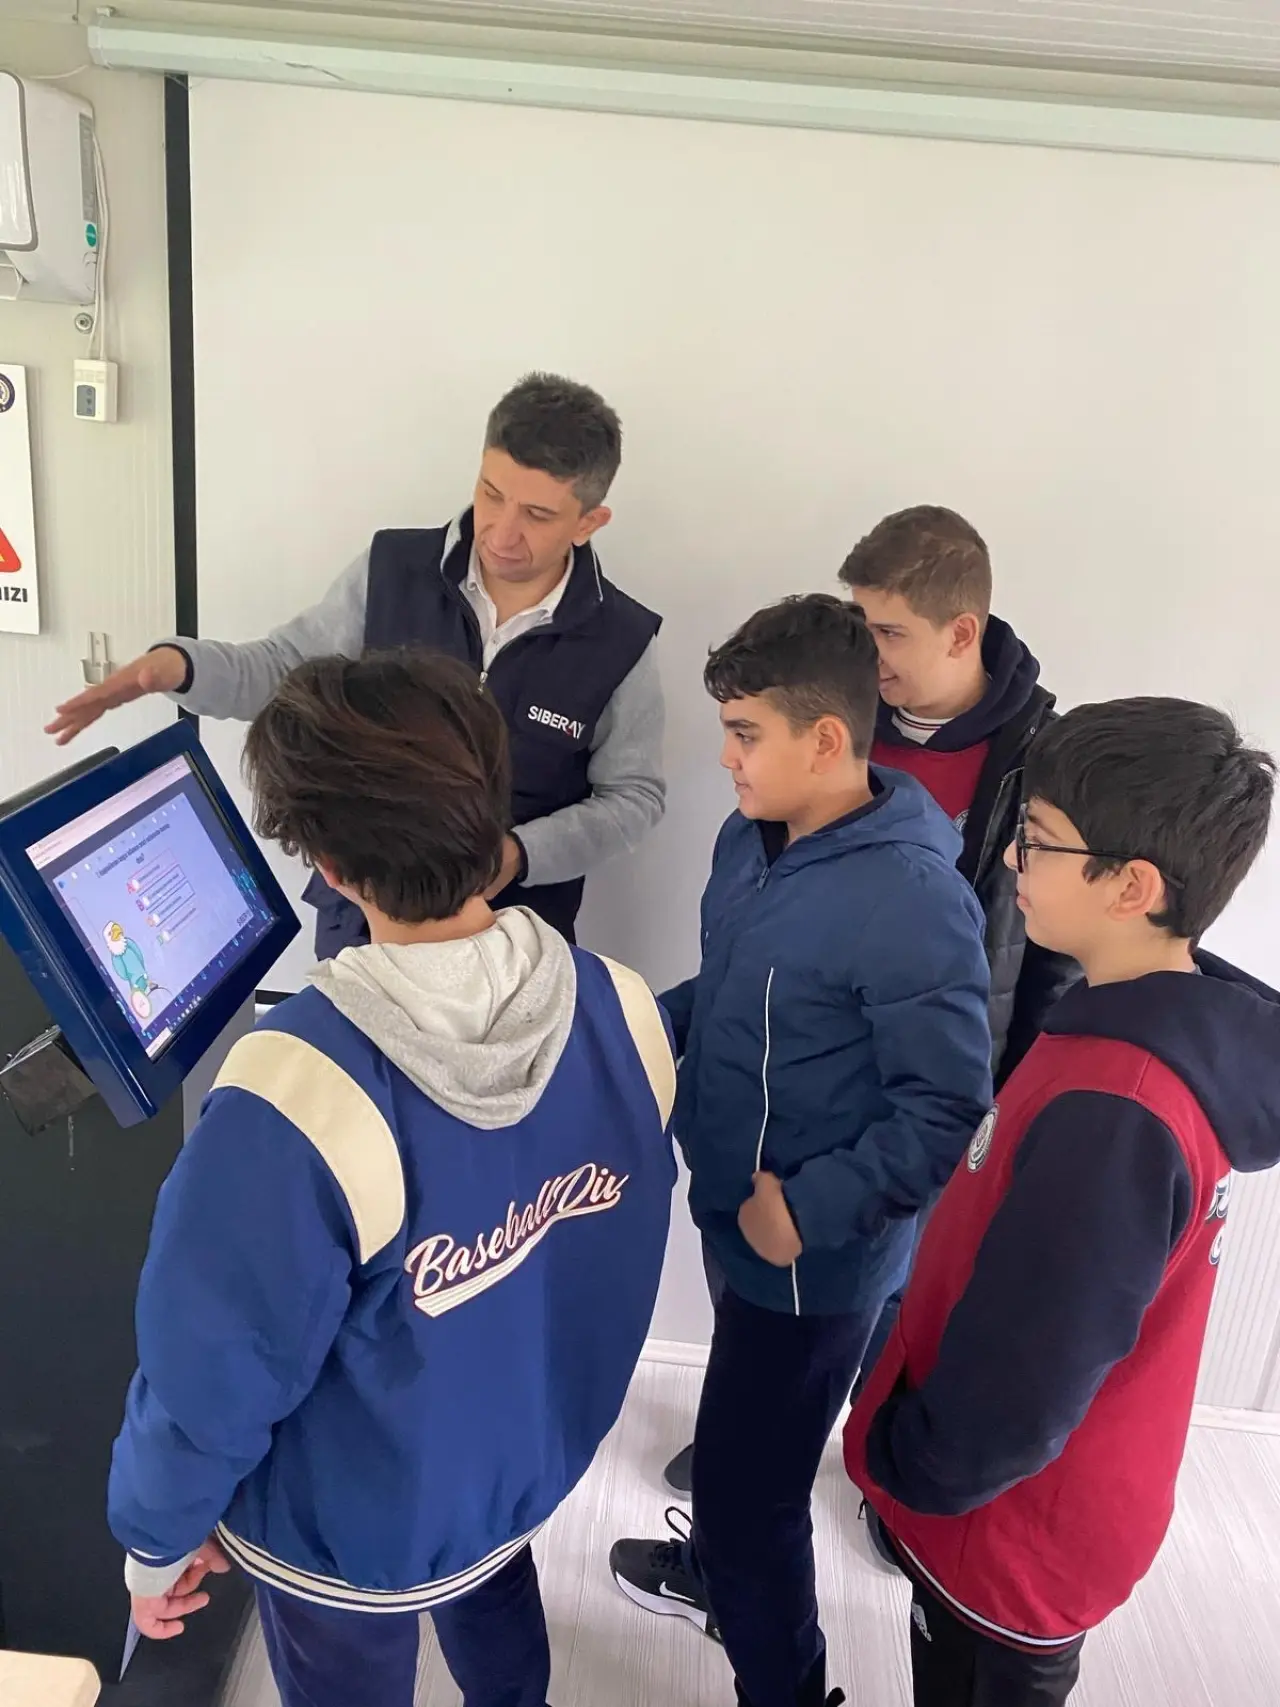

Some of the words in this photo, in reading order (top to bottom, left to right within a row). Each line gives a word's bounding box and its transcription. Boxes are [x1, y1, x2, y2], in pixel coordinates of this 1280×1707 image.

[0, 586, 28, 603] IZI
[527, 705, 587, 740] SIBERAY
[403, 1176, 562, 1297] Baseball
